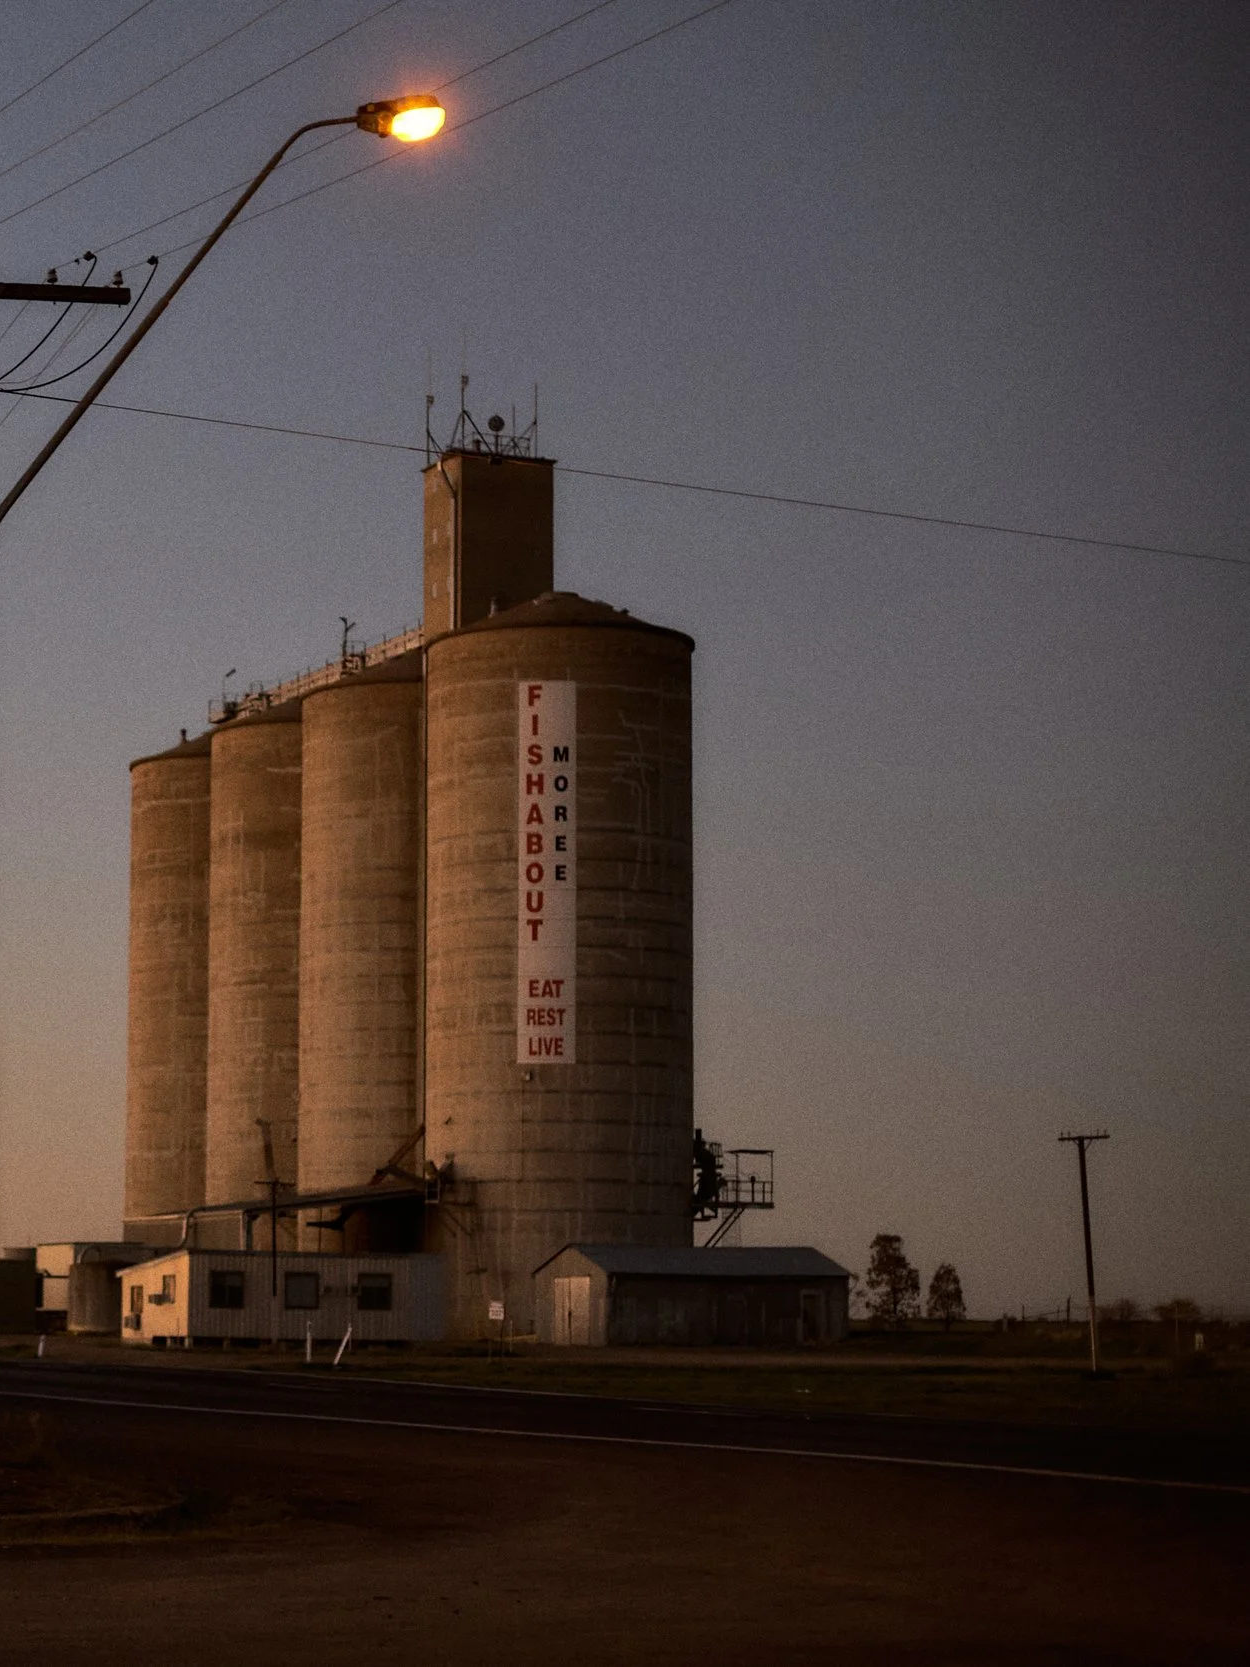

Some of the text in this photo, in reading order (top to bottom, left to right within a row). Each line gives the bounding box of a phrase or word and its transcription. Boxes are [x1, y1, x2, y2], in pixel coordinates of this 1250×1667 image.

[526, 685, 545, 941] FISHABOUT
[553, 746, 569, 881] MOREE
[528, 979, 565, 998] EAT
[526, 1008, 566, 1026] REST
[528, 1037, 564, 1056] LIVE
